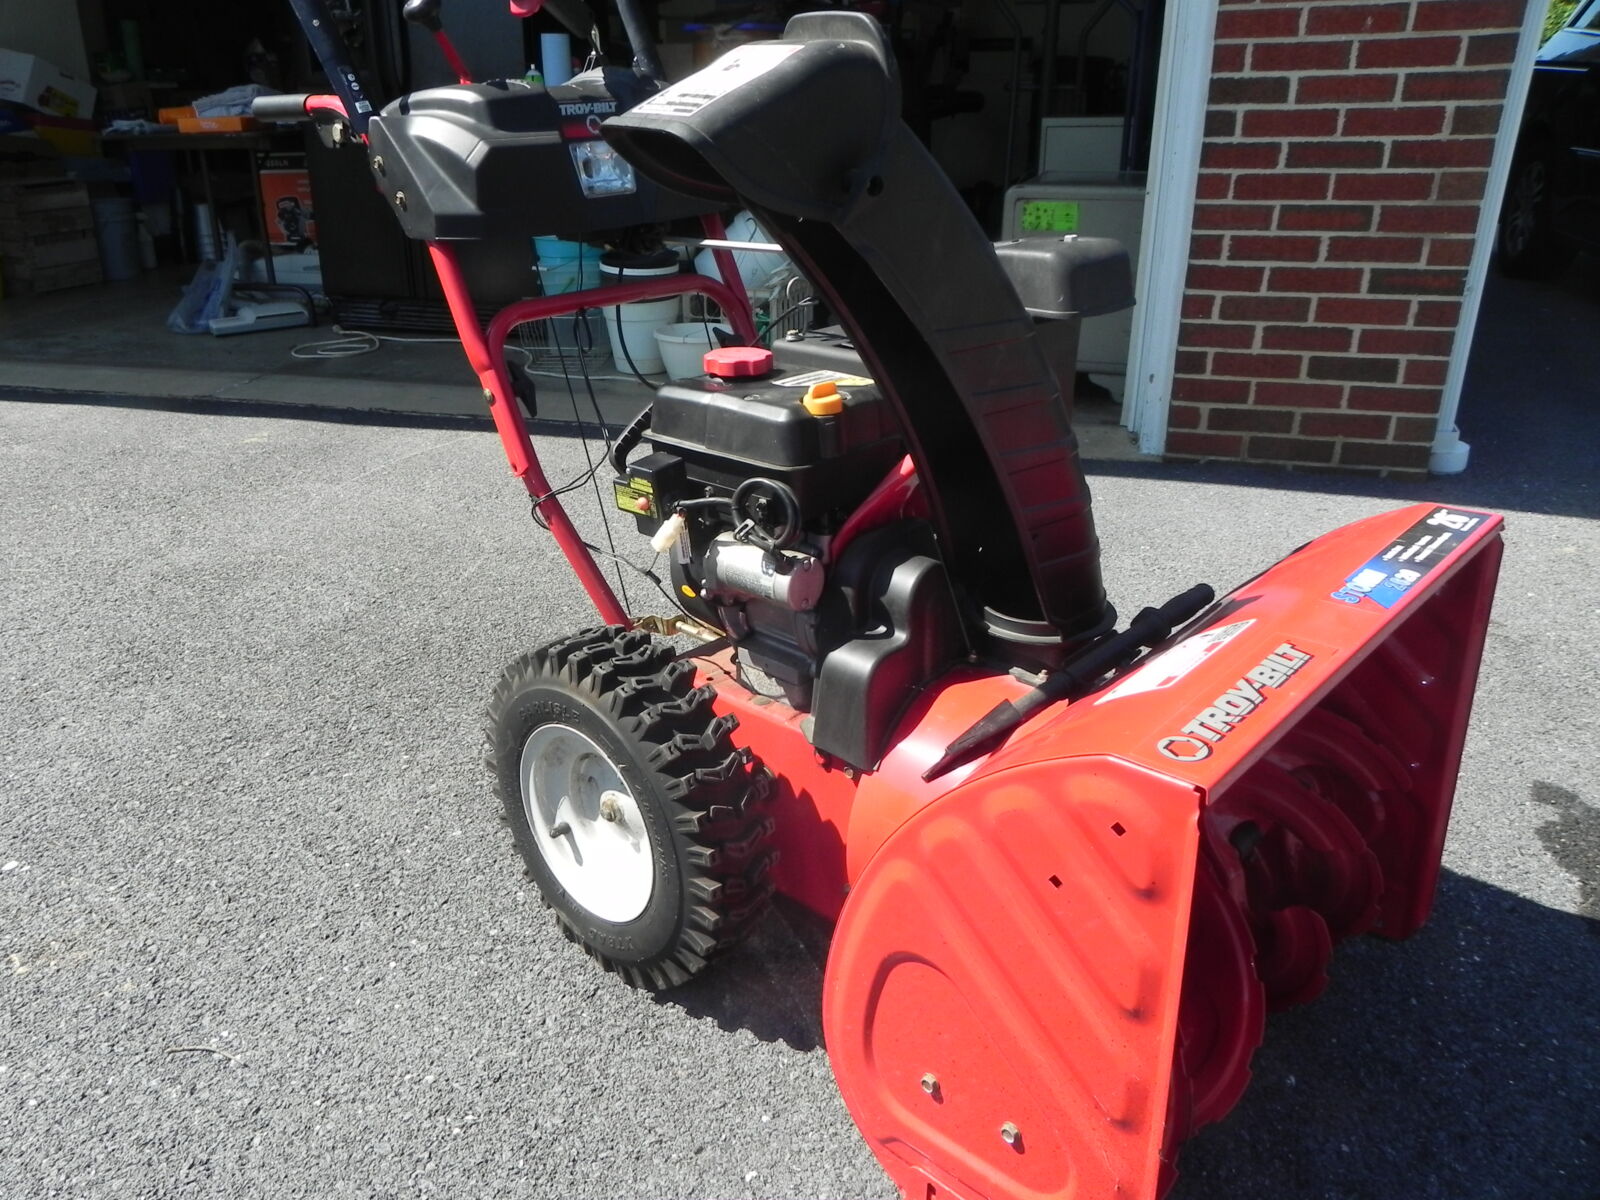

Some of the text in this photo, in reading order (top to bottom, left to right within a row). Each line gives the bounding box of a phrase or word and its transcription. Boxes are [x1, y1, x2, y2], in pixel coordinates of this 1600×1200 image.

[558, 101, 617, 116] TROY-BILT
[1330, 568, 1388, 604] STO
[1180, 640, 1314, 743] TROY-BILT
